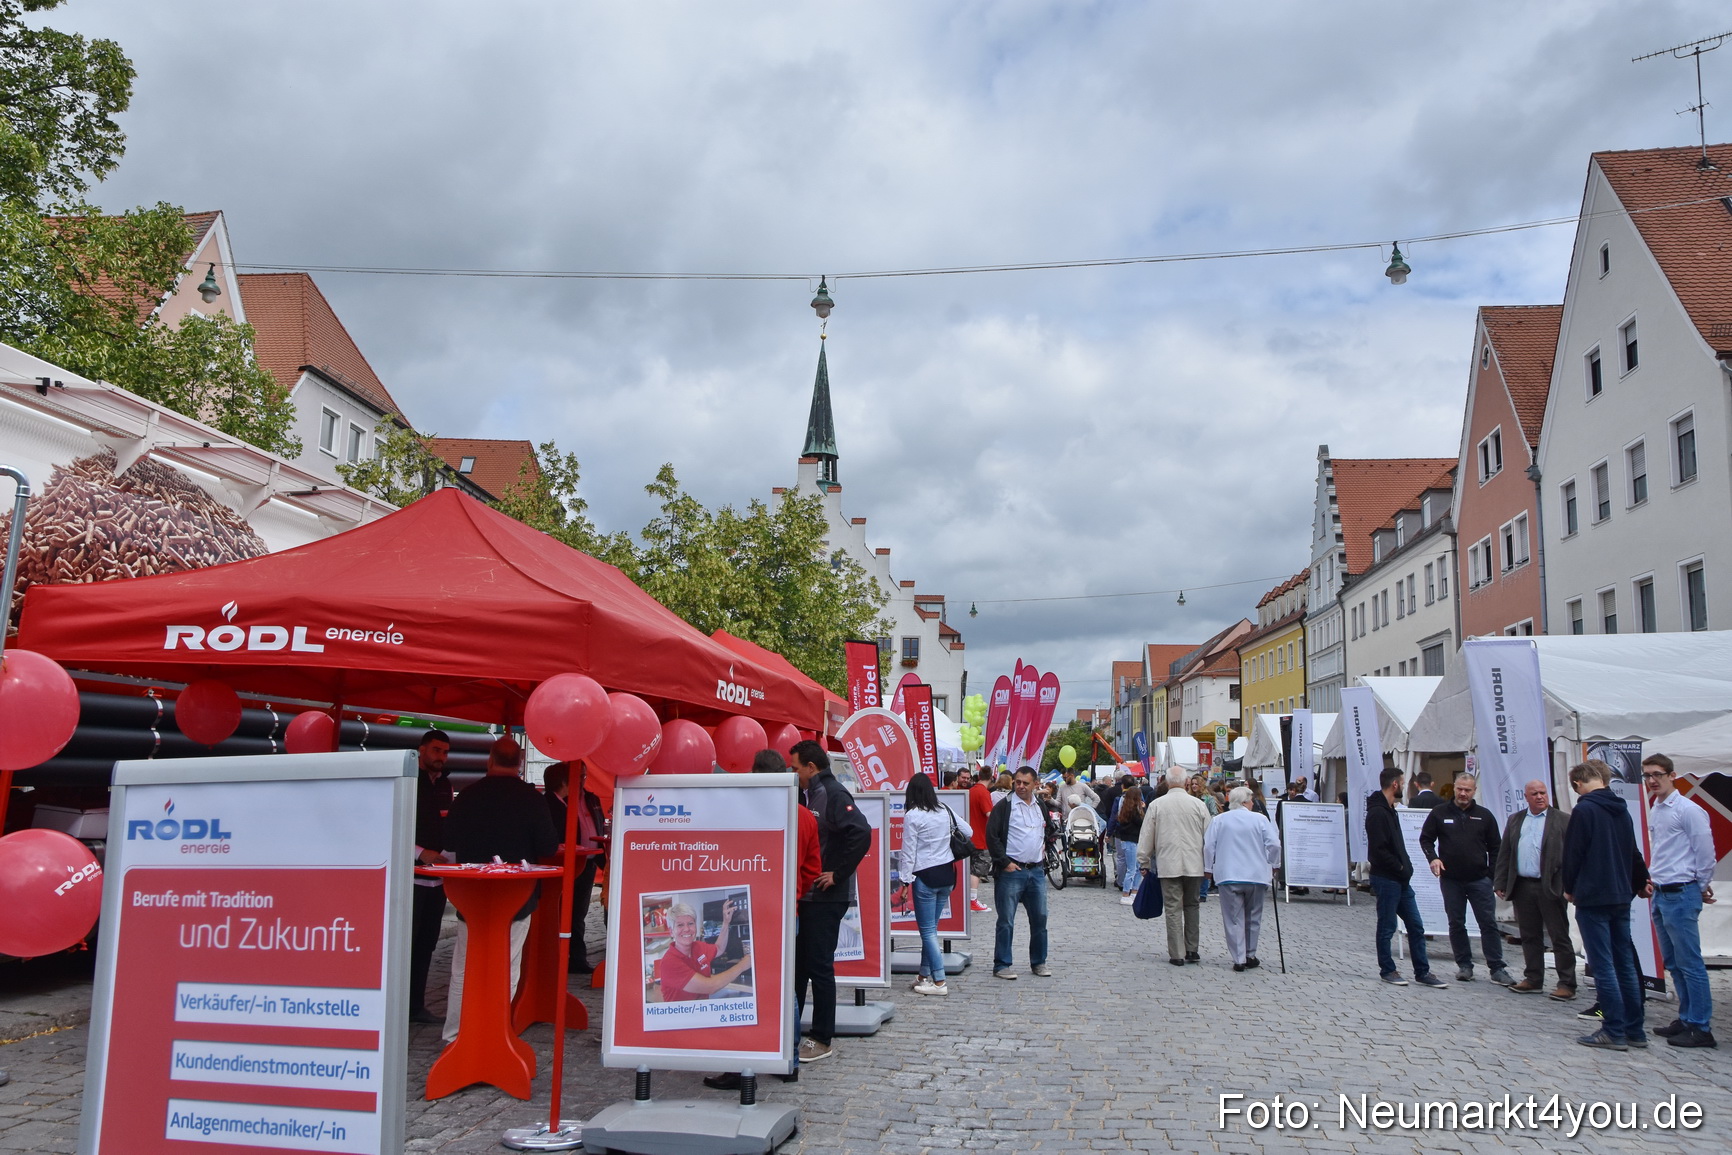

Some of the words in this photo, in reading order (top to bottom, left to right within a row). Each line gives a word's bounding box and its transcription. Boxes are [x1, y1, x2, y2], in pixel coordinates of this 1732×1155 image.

[325, 613, 404, 645] energie
[918, 700, 934, 775] Büromöbel
[658, 815, 691, 824] energie
[180, 840, 231, 854] energie
[630, 841, 660, 851] Berufe
[661, 841, 677, 851] mit
[679, 841, 719, 851] Tradition
[661, 854, 693, 872] und
[698, 854, 772, 872] Zukunft.
[132, 890, 180, 908] Berufe
[181, 890, 208, 908] mit
[209, 891, 273, 909] Tradition
[179, 915, 231, 948] und
[238, 917, 361, 952] Zukunft.
[834, 950, 862, 958] ankstelle
[180, 993, 277, 1014] Verkäufer/-in
[280, 997, 360, 1017] Tankstelle
[646, 1003, 708, 1016] Mitarbeiter/-in
[709, 1001, 754, 1012] Tankstelle
[720, 1014, 727, 1023] &
[729, 1013, 755, 1022] Bistro
[175, 1052, 370, 1080] Kundendienstmonteur/-in
[170, 1111, 346, 1141] Anlagenmechaniker/-in
